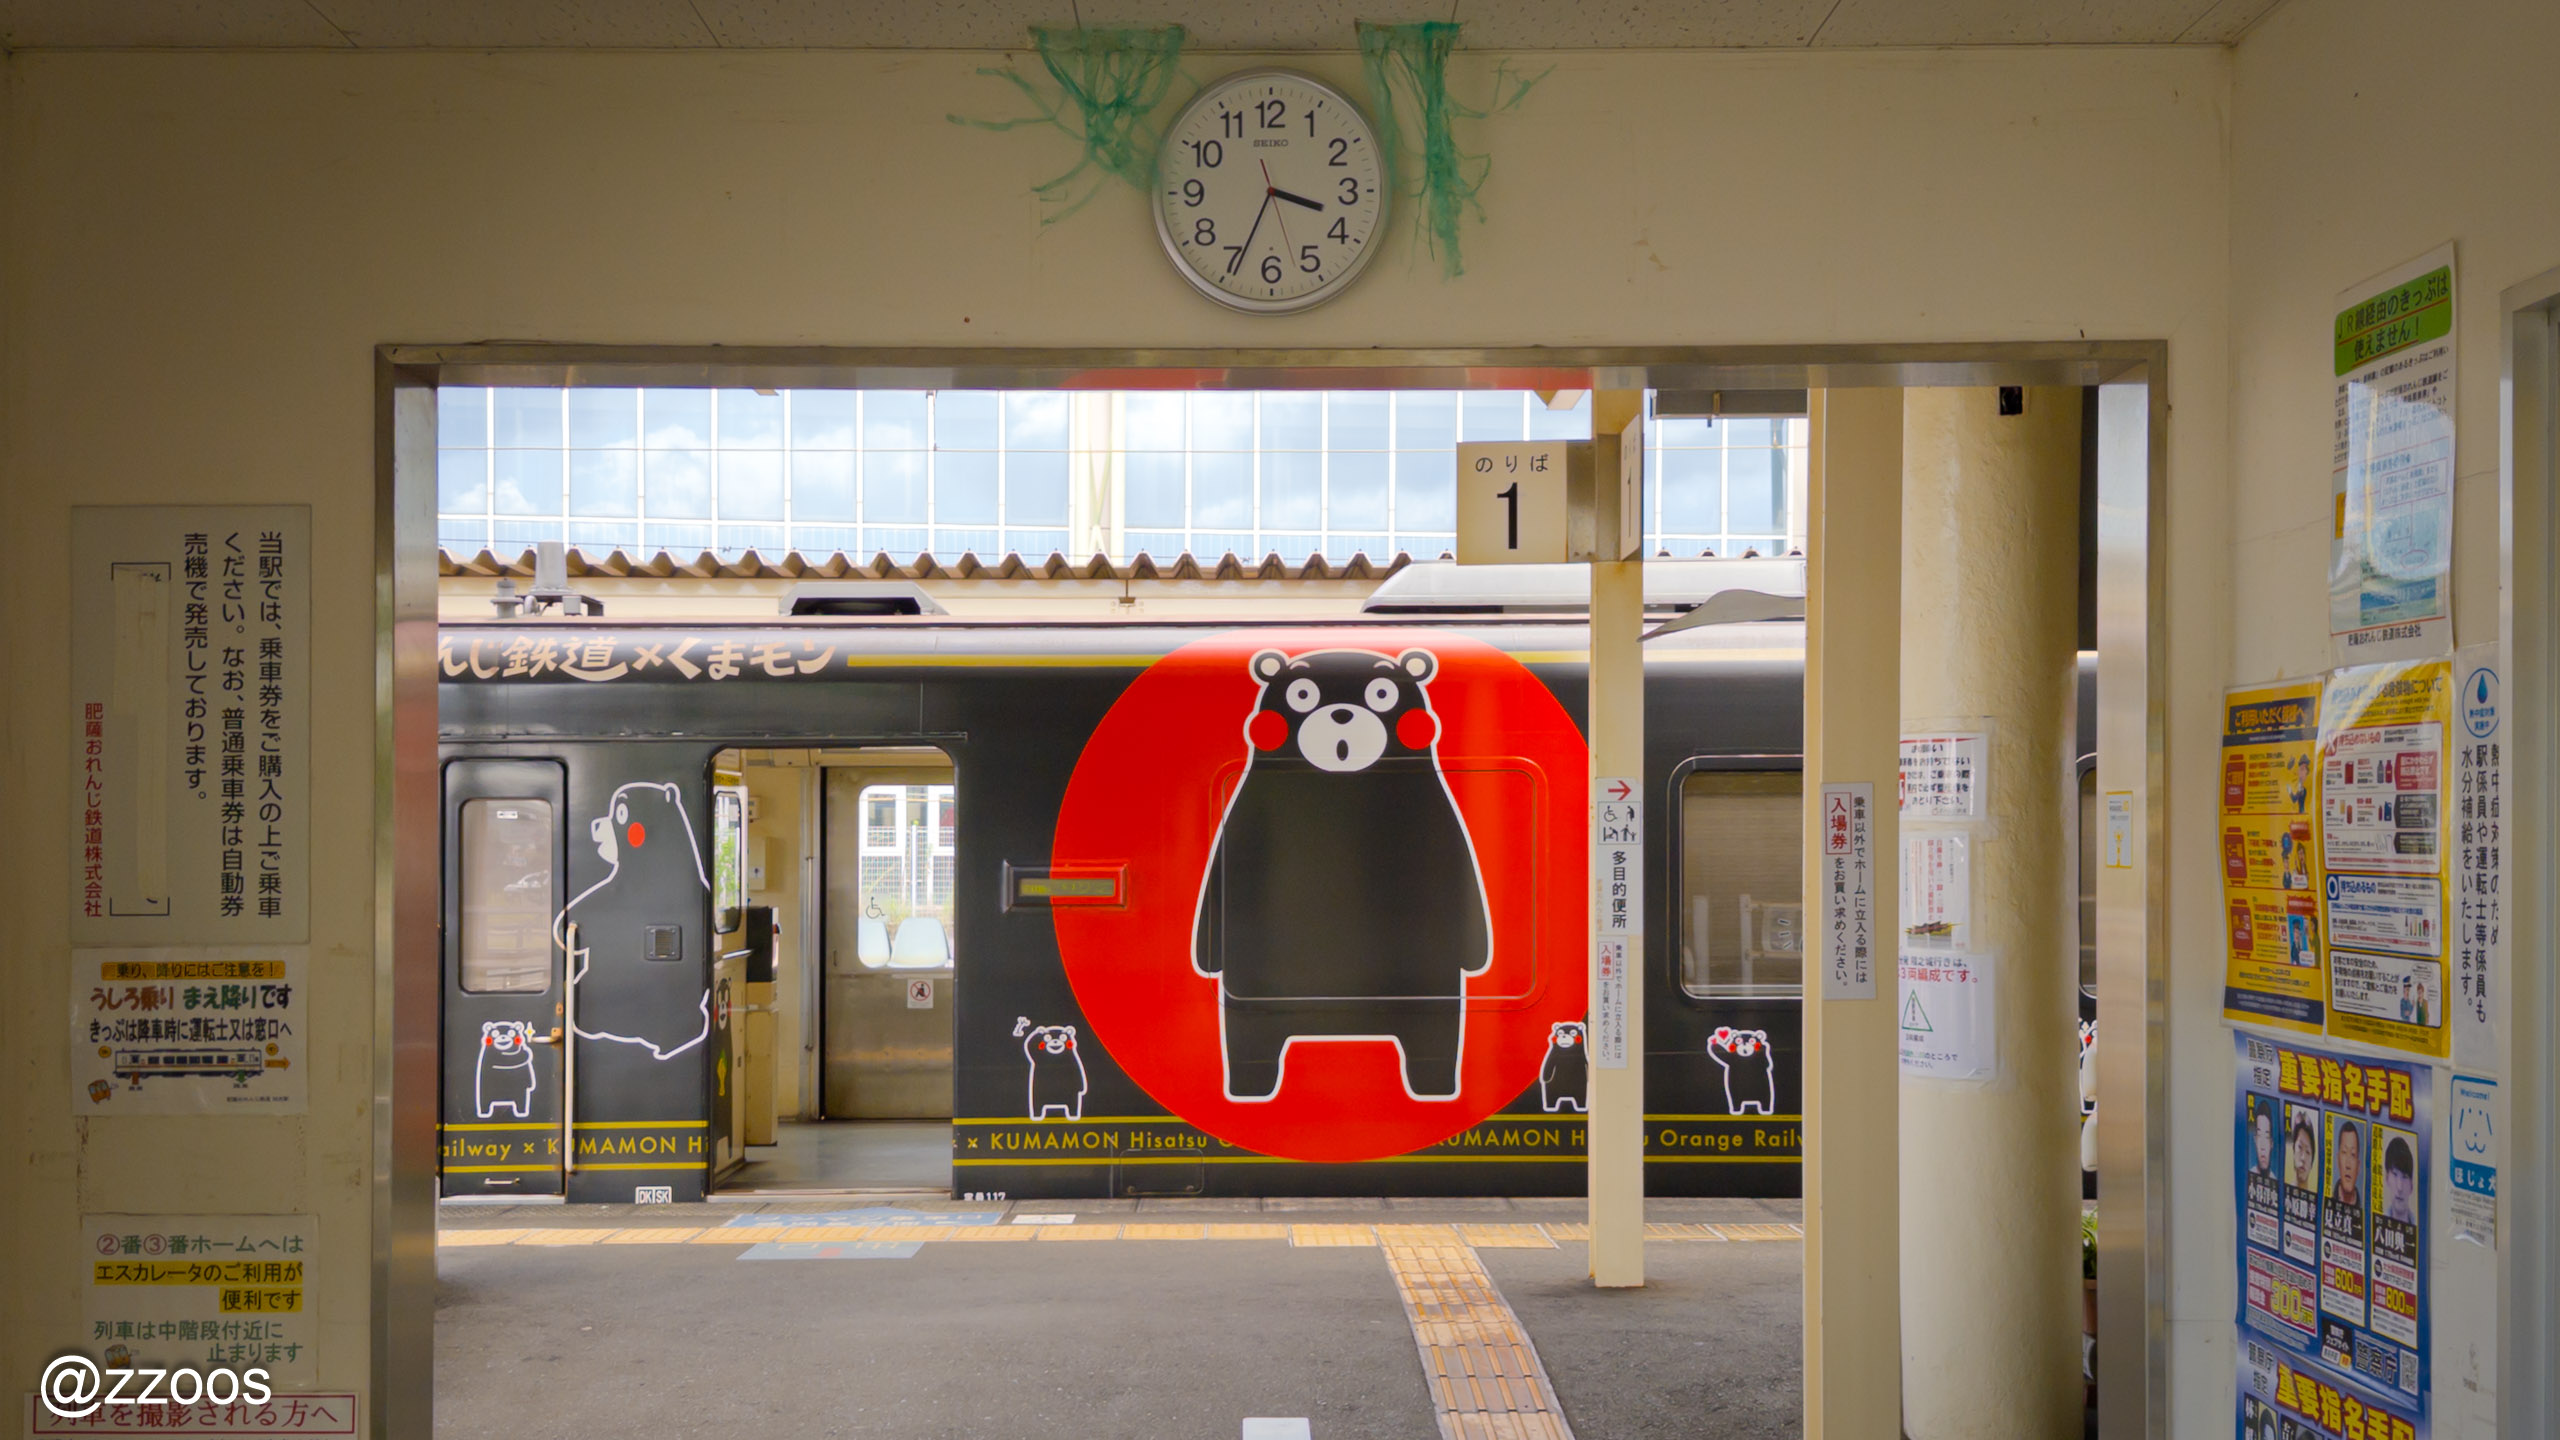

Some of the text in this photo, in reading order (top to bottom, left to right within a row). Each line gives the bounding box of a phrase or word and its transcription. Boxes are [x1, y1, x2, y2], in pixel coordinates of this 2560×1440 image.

[1220, 111, 1243, 138] 11
[1255, 100, 1286, 128] 12
[1304, 110, 1315, 137] 1
[1191, 140, 1223, 168] 10
[1253, 139, 1289, 147] SEIKO
[1328, 137, 1348, 166] 2
[1183, 179, 1205, 207] 9
[1338, 177, 1359, 205] 3
[1194, 217, 1216, 246] 8
[1327, 216, 1349, 245] 4
[1223, 246, 1243, 273] 7
[1261, 255, 1282, 284] 6
[1300, 245, 1321, 273] 5
[1475, 454, 1549, 473] のりば
[1497, 482, 1518, 549] 1
[184, 532, 208, 800] 売機で発売しております。
[220, 532, 246, 917] ください。なお、普通乗車券は自動券
[258, 531, 283, 918] 当駅では、乗車券をご購入の上ご乗車
[84, 703, 103, 917] 肥薩おれんじ鉄道株式会社
[1612, 850, 1627, 929] 多目的便所
[2277, 1049, 2414, 1123] 重要指名手配
[547, 1135, 677, 1155] KMAMON
[990, 1131, 1120, 1151] KUMAMON
[1130, 1131, 1208, 1150] Hisatsu
[1660, 1129, 1743, 1151] Orange
[97, 1262, 303, 1282] エスカレータのご利用が
[222, 1289, 301, 1311] 便利です
[94, 1320, 283, 1341] 列車は中階段付近に
[207, 1342, 303, 1363] 止まります
